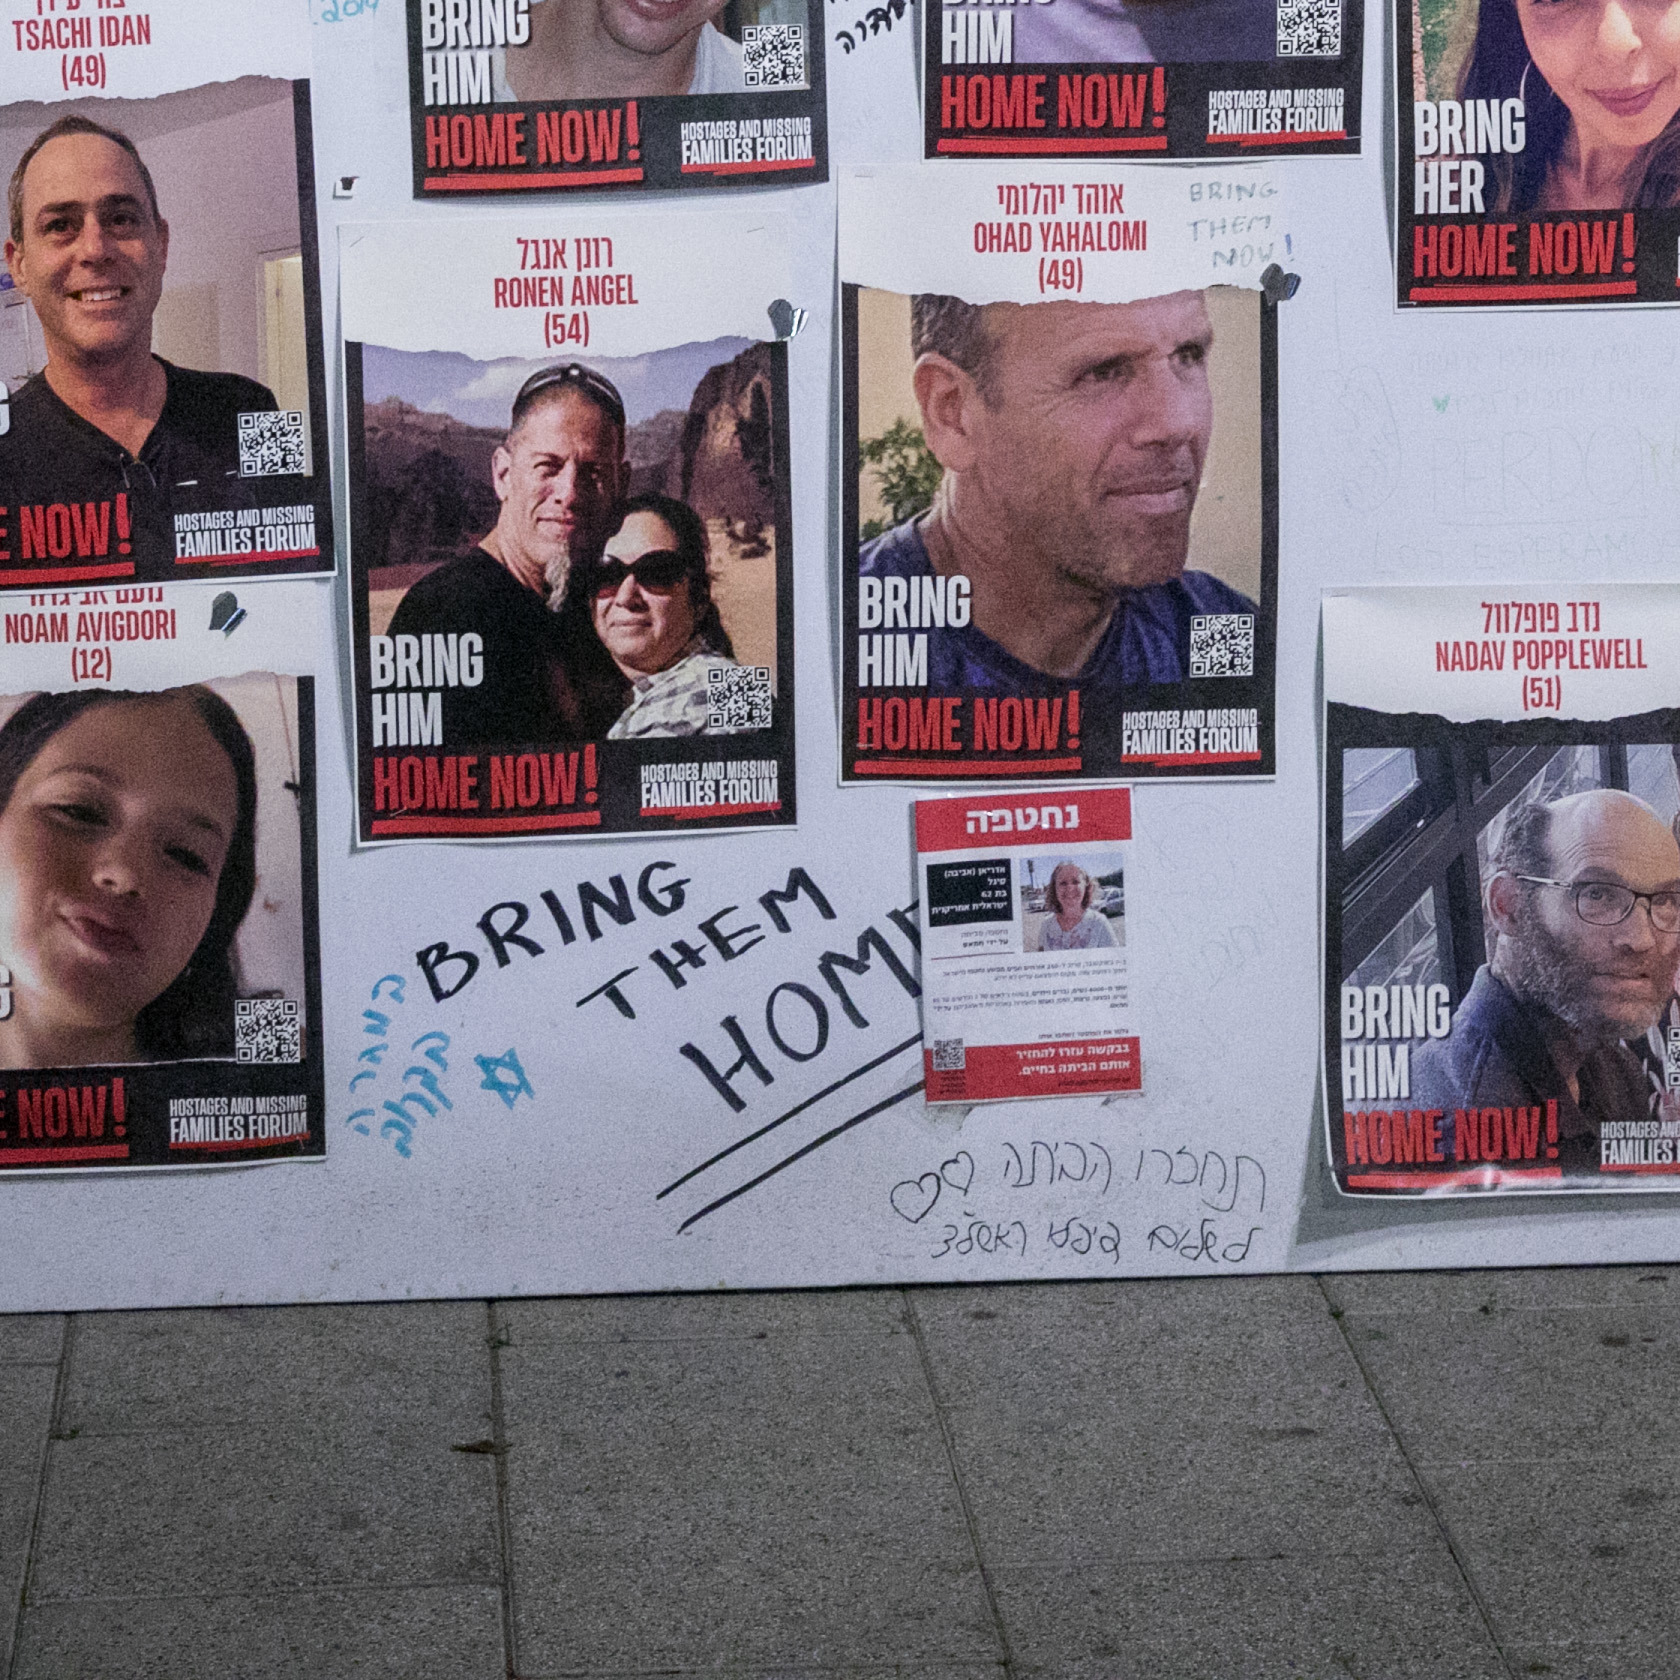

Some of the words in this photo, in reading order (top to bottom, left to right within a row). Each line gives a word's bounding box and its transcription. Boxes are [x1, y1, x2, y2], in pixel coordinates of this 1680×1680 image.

[12, 17, 93, 51] TSACHI
[98, 14, 151, 47] IDAN
[61, 53, 107, 91] (49)
[973, 221, 1033, 254] OHAD
[1039, 220, 1147, 253] YAHALOMI
[493, 275, 564, 309] RONEN
[570, 273, 638, 306] ANGEL
[1038, 257, 1084, 293] (49)
[543, 311, 590, 347] (54)
[4, 612, 69, 644] NOAM
[75, 608, 177, 643] AVIGDORI
[70, 646, 113, 683] (12)
[1435, 640, 1506, 672] NADAV
[1512, 638, 1647, 671] POPPLEWELL
[1521, 675, 1562, 711] (51)
[966, 804, 1080, 834] נחטפה
[417, 861, 691, 1002] BRING
[576, 867, 837, 1019] THEM
